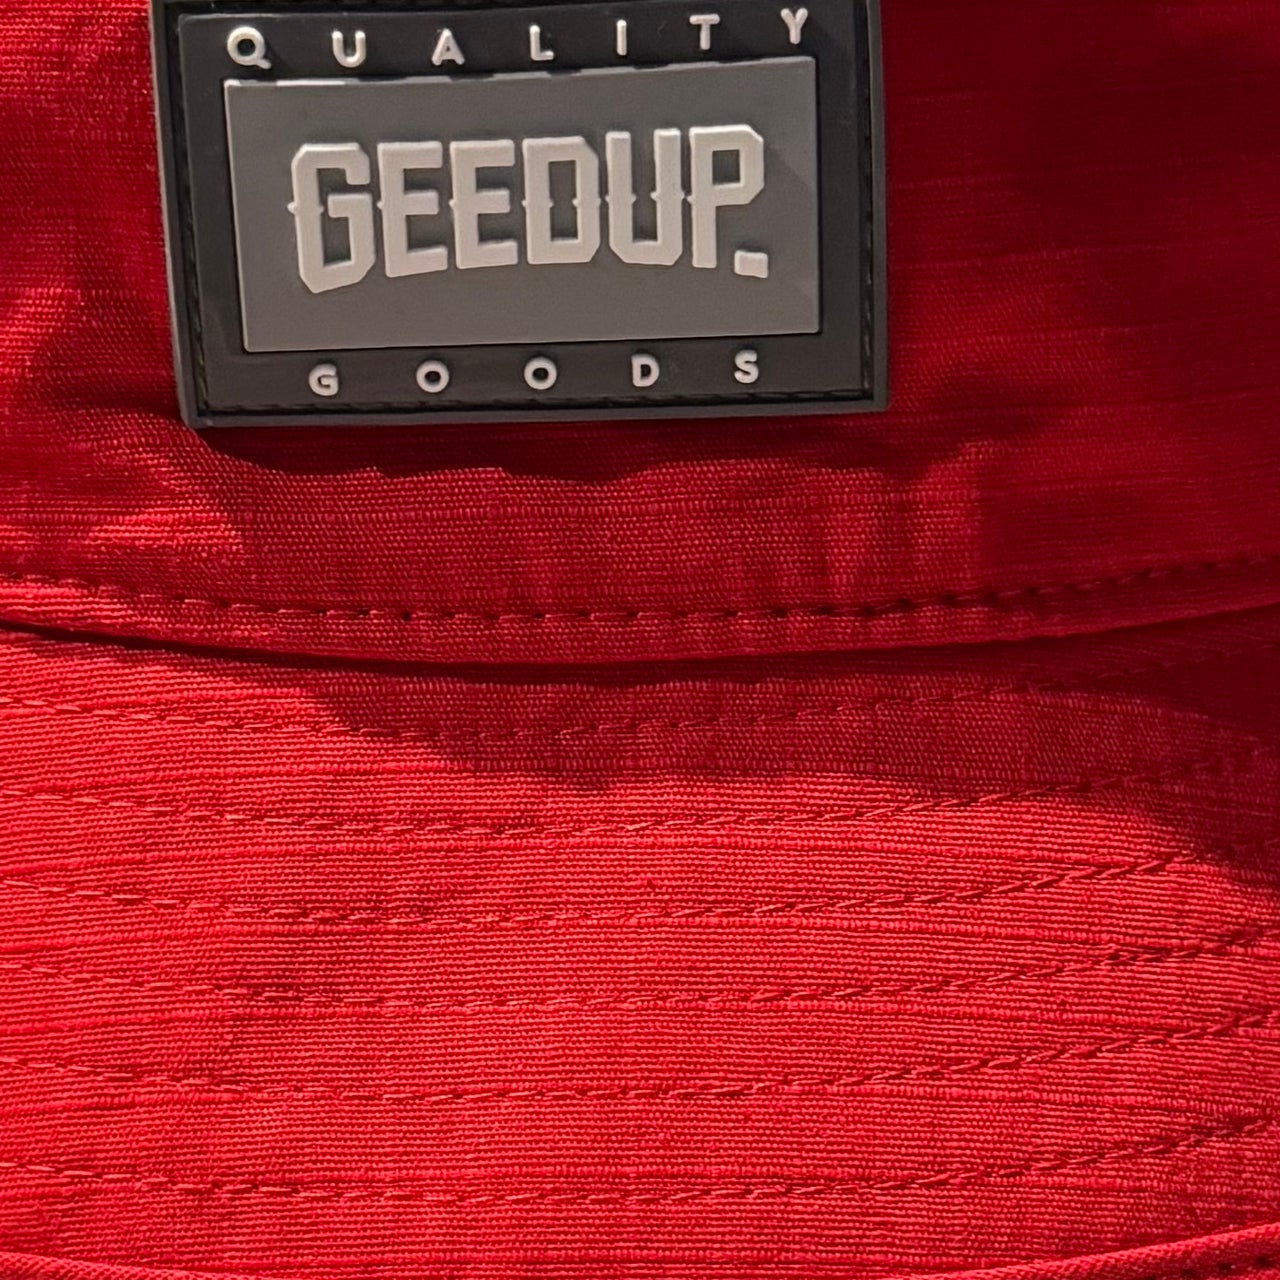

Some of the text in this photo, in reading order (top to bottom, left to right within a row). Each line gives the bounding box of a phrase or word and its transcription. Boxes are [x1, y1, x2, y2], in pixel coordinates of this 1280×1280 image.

[226, 7, 809, 69] QUALITY
[288, 123, 768, 293] GEEDUP.
[308, 350, 759, 397] GOODS
